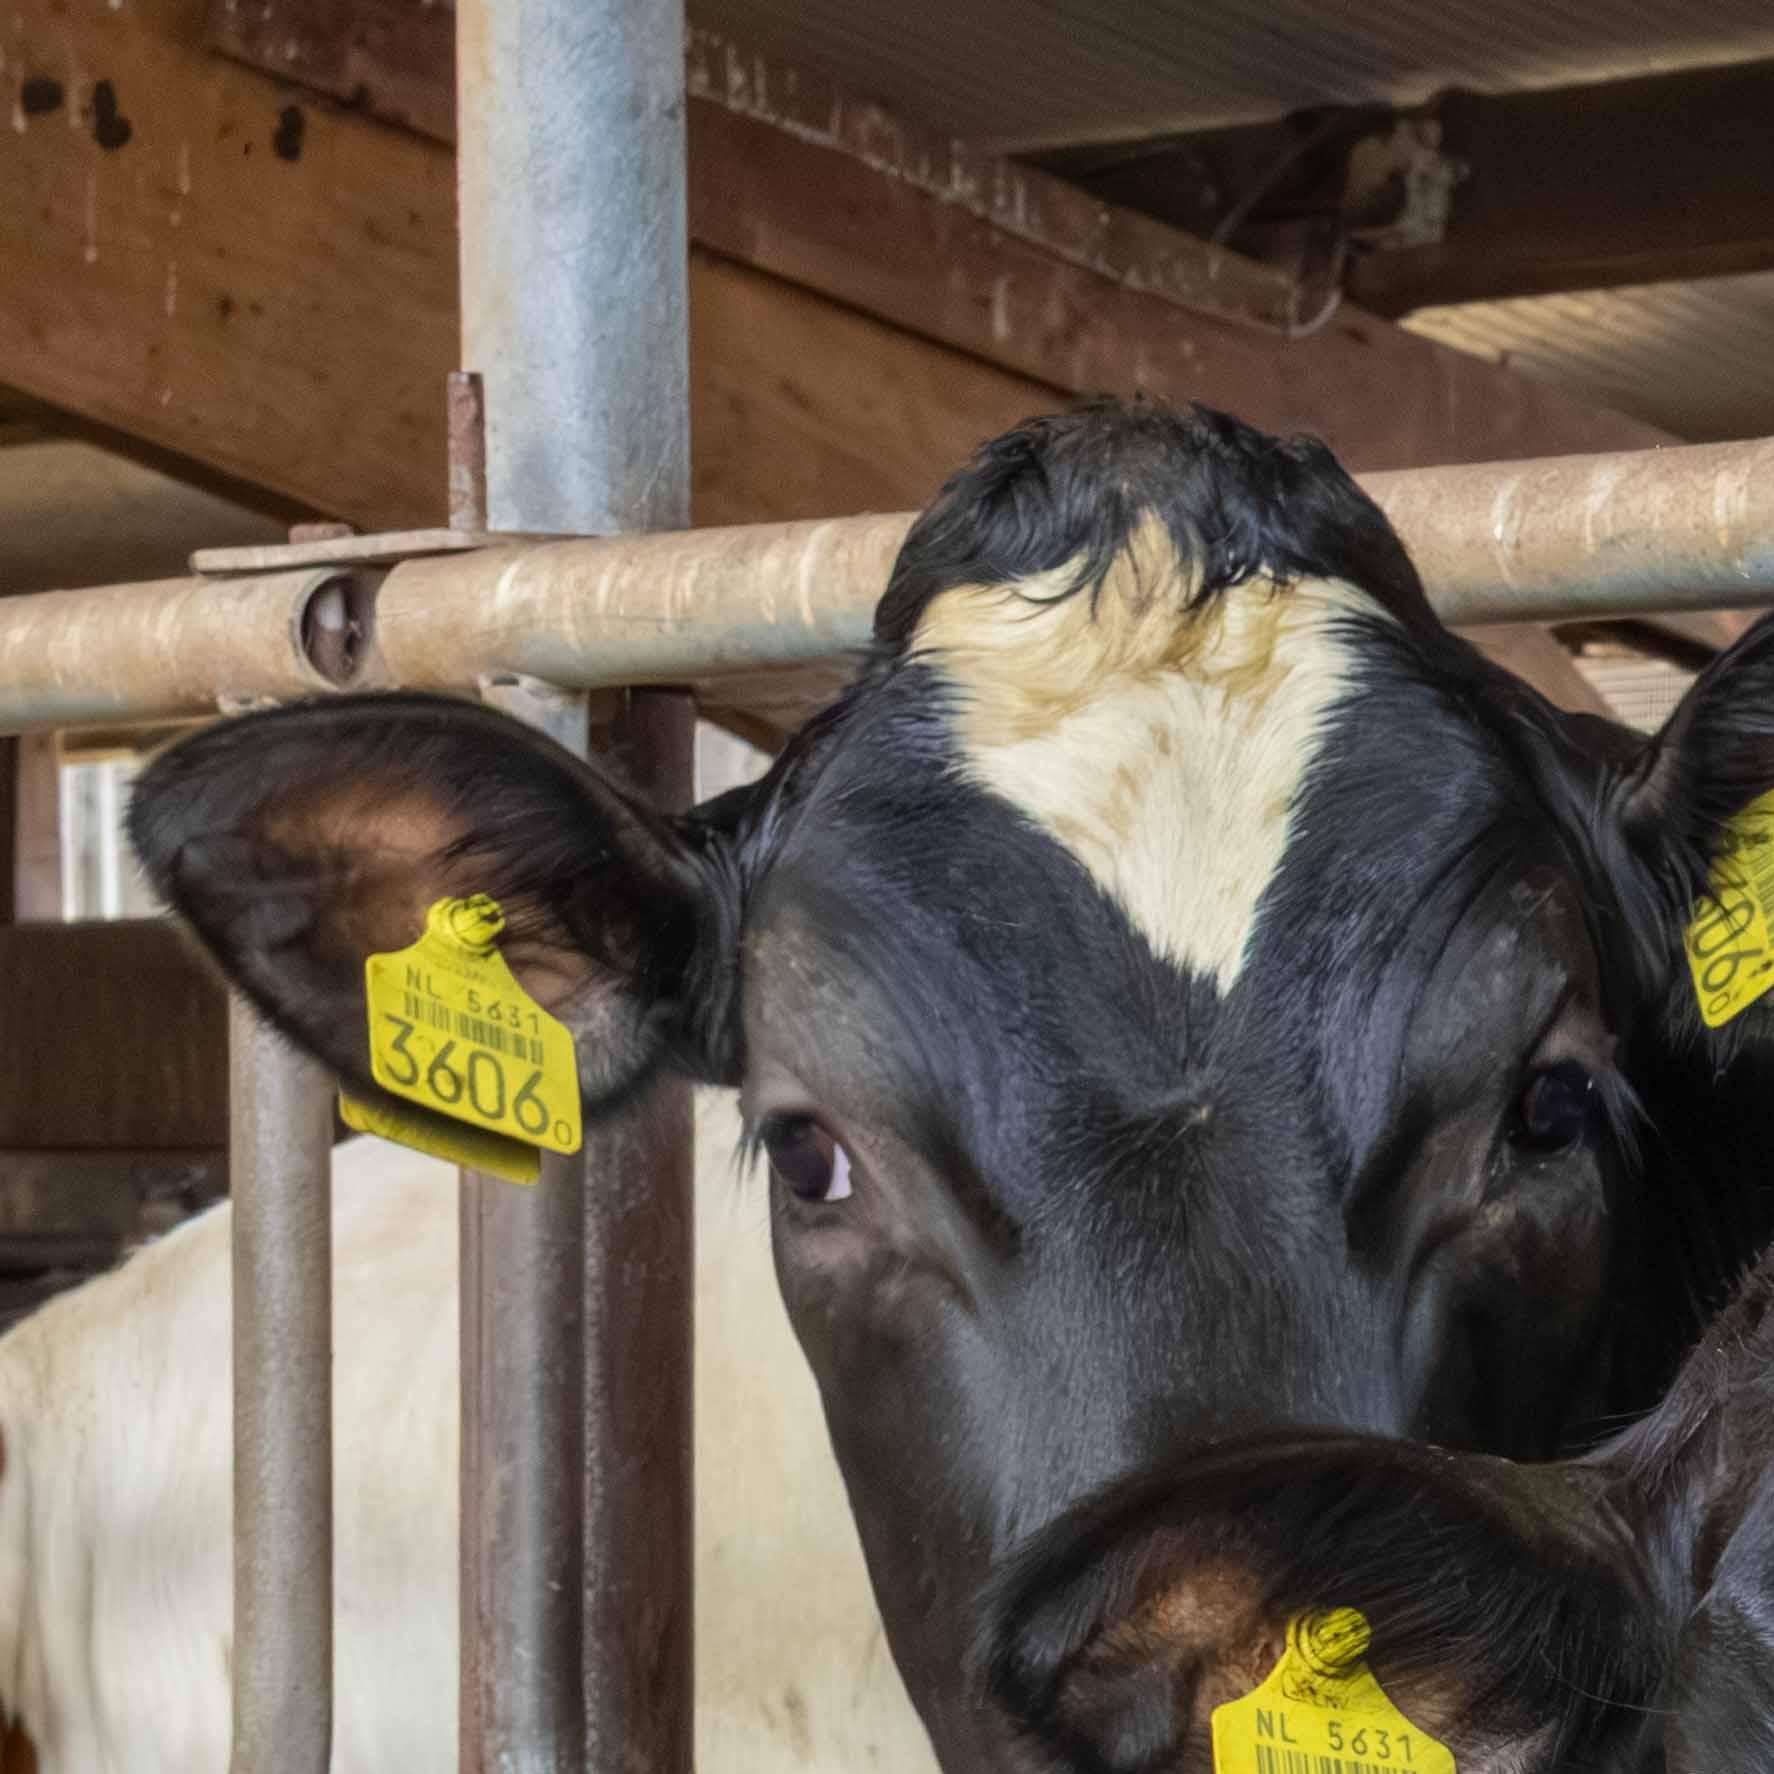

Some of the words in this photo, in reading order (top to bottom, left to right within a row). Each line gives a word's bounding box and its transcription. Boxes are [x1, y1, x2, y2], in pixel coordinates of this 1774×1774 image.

[406, 964, 441, 999] NL
[467, 988, 540, 1035] 5631
[1256, 1708, 1297, 1744] NL
[1327, 1720, 1413, 1762] 5631
